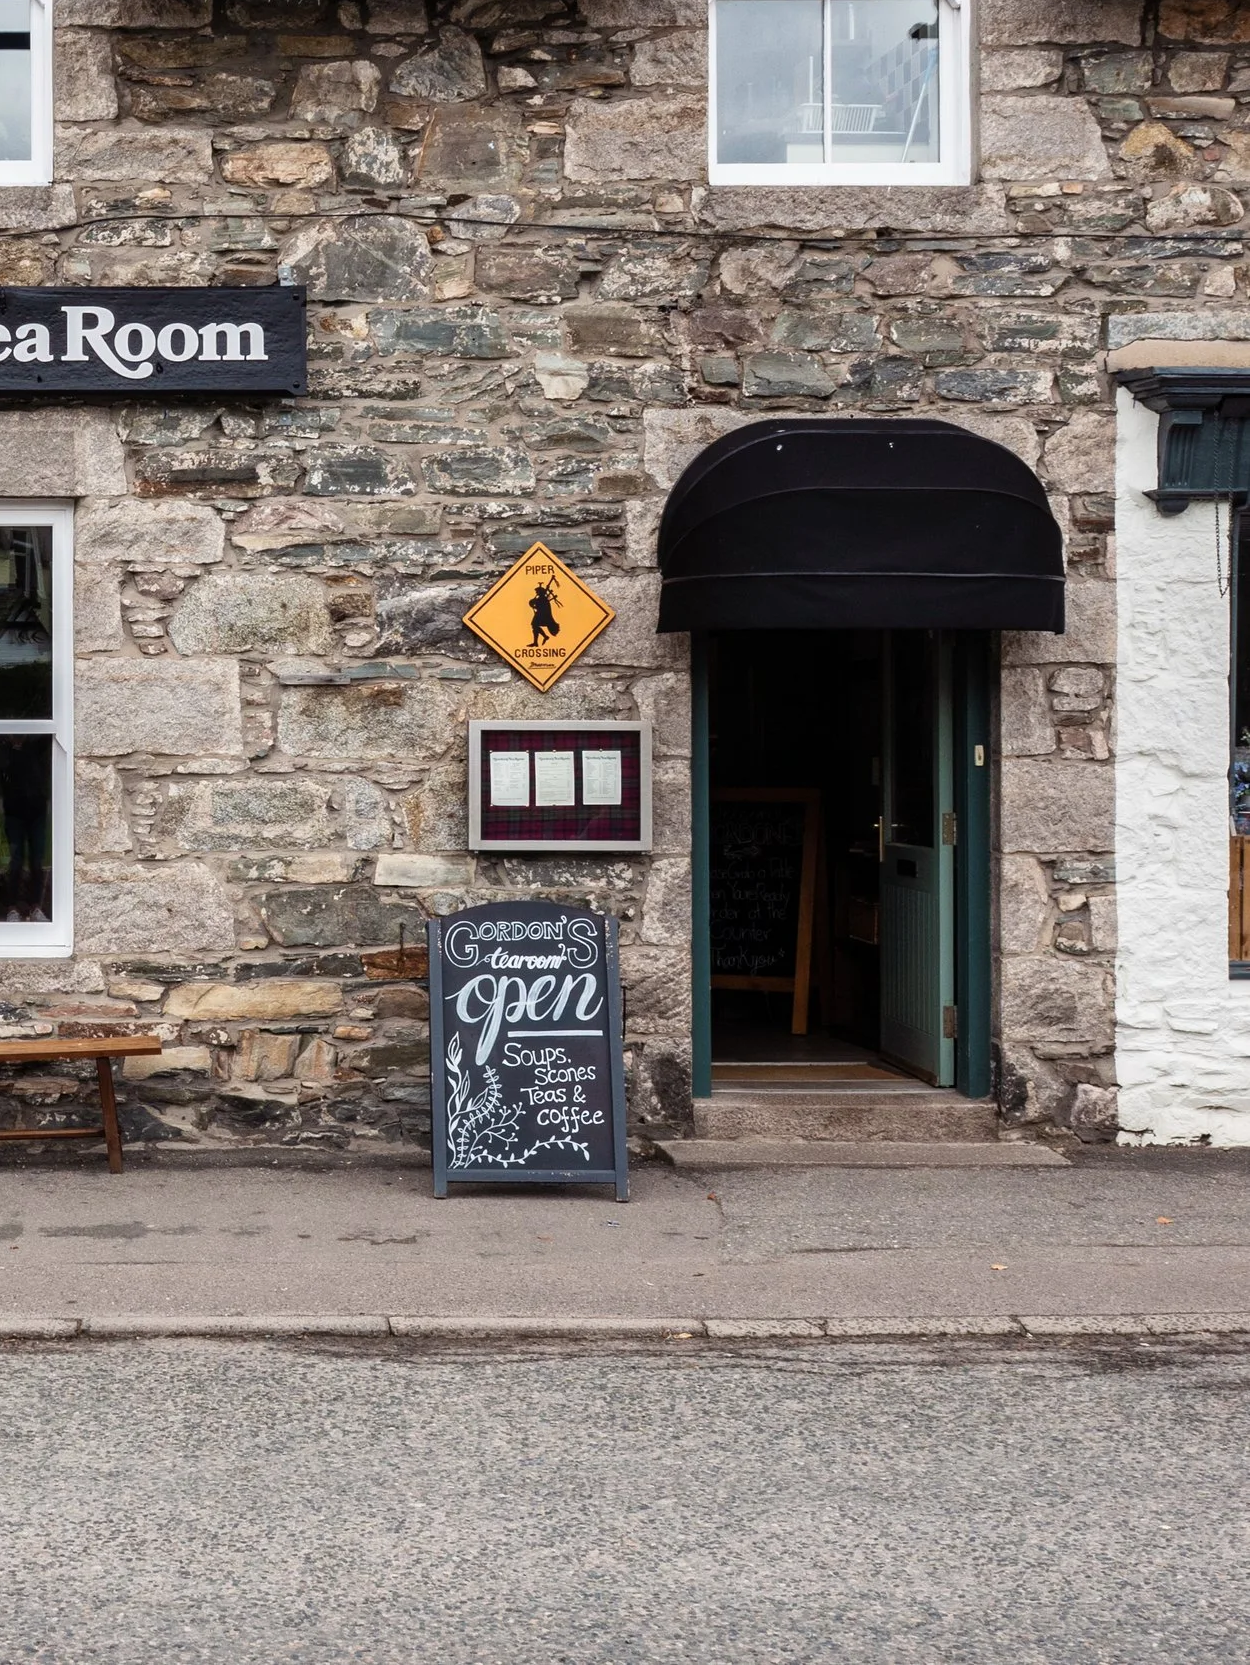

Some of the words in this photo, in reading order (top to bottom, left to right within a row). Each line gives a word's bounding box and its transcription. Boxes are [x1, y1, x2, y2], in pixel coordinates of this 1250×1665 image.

[61, 305, 269, 379] Room
[525, 564, 555, 575] PIPER
[514, 647, 567, 658] CROSSING
[445, 916, 598, 969] GORDON'S
[445, 972, 603, 1066] open
[520, 1086, 567, 1105] Teas
[573, 1084, 586, 1103] &
